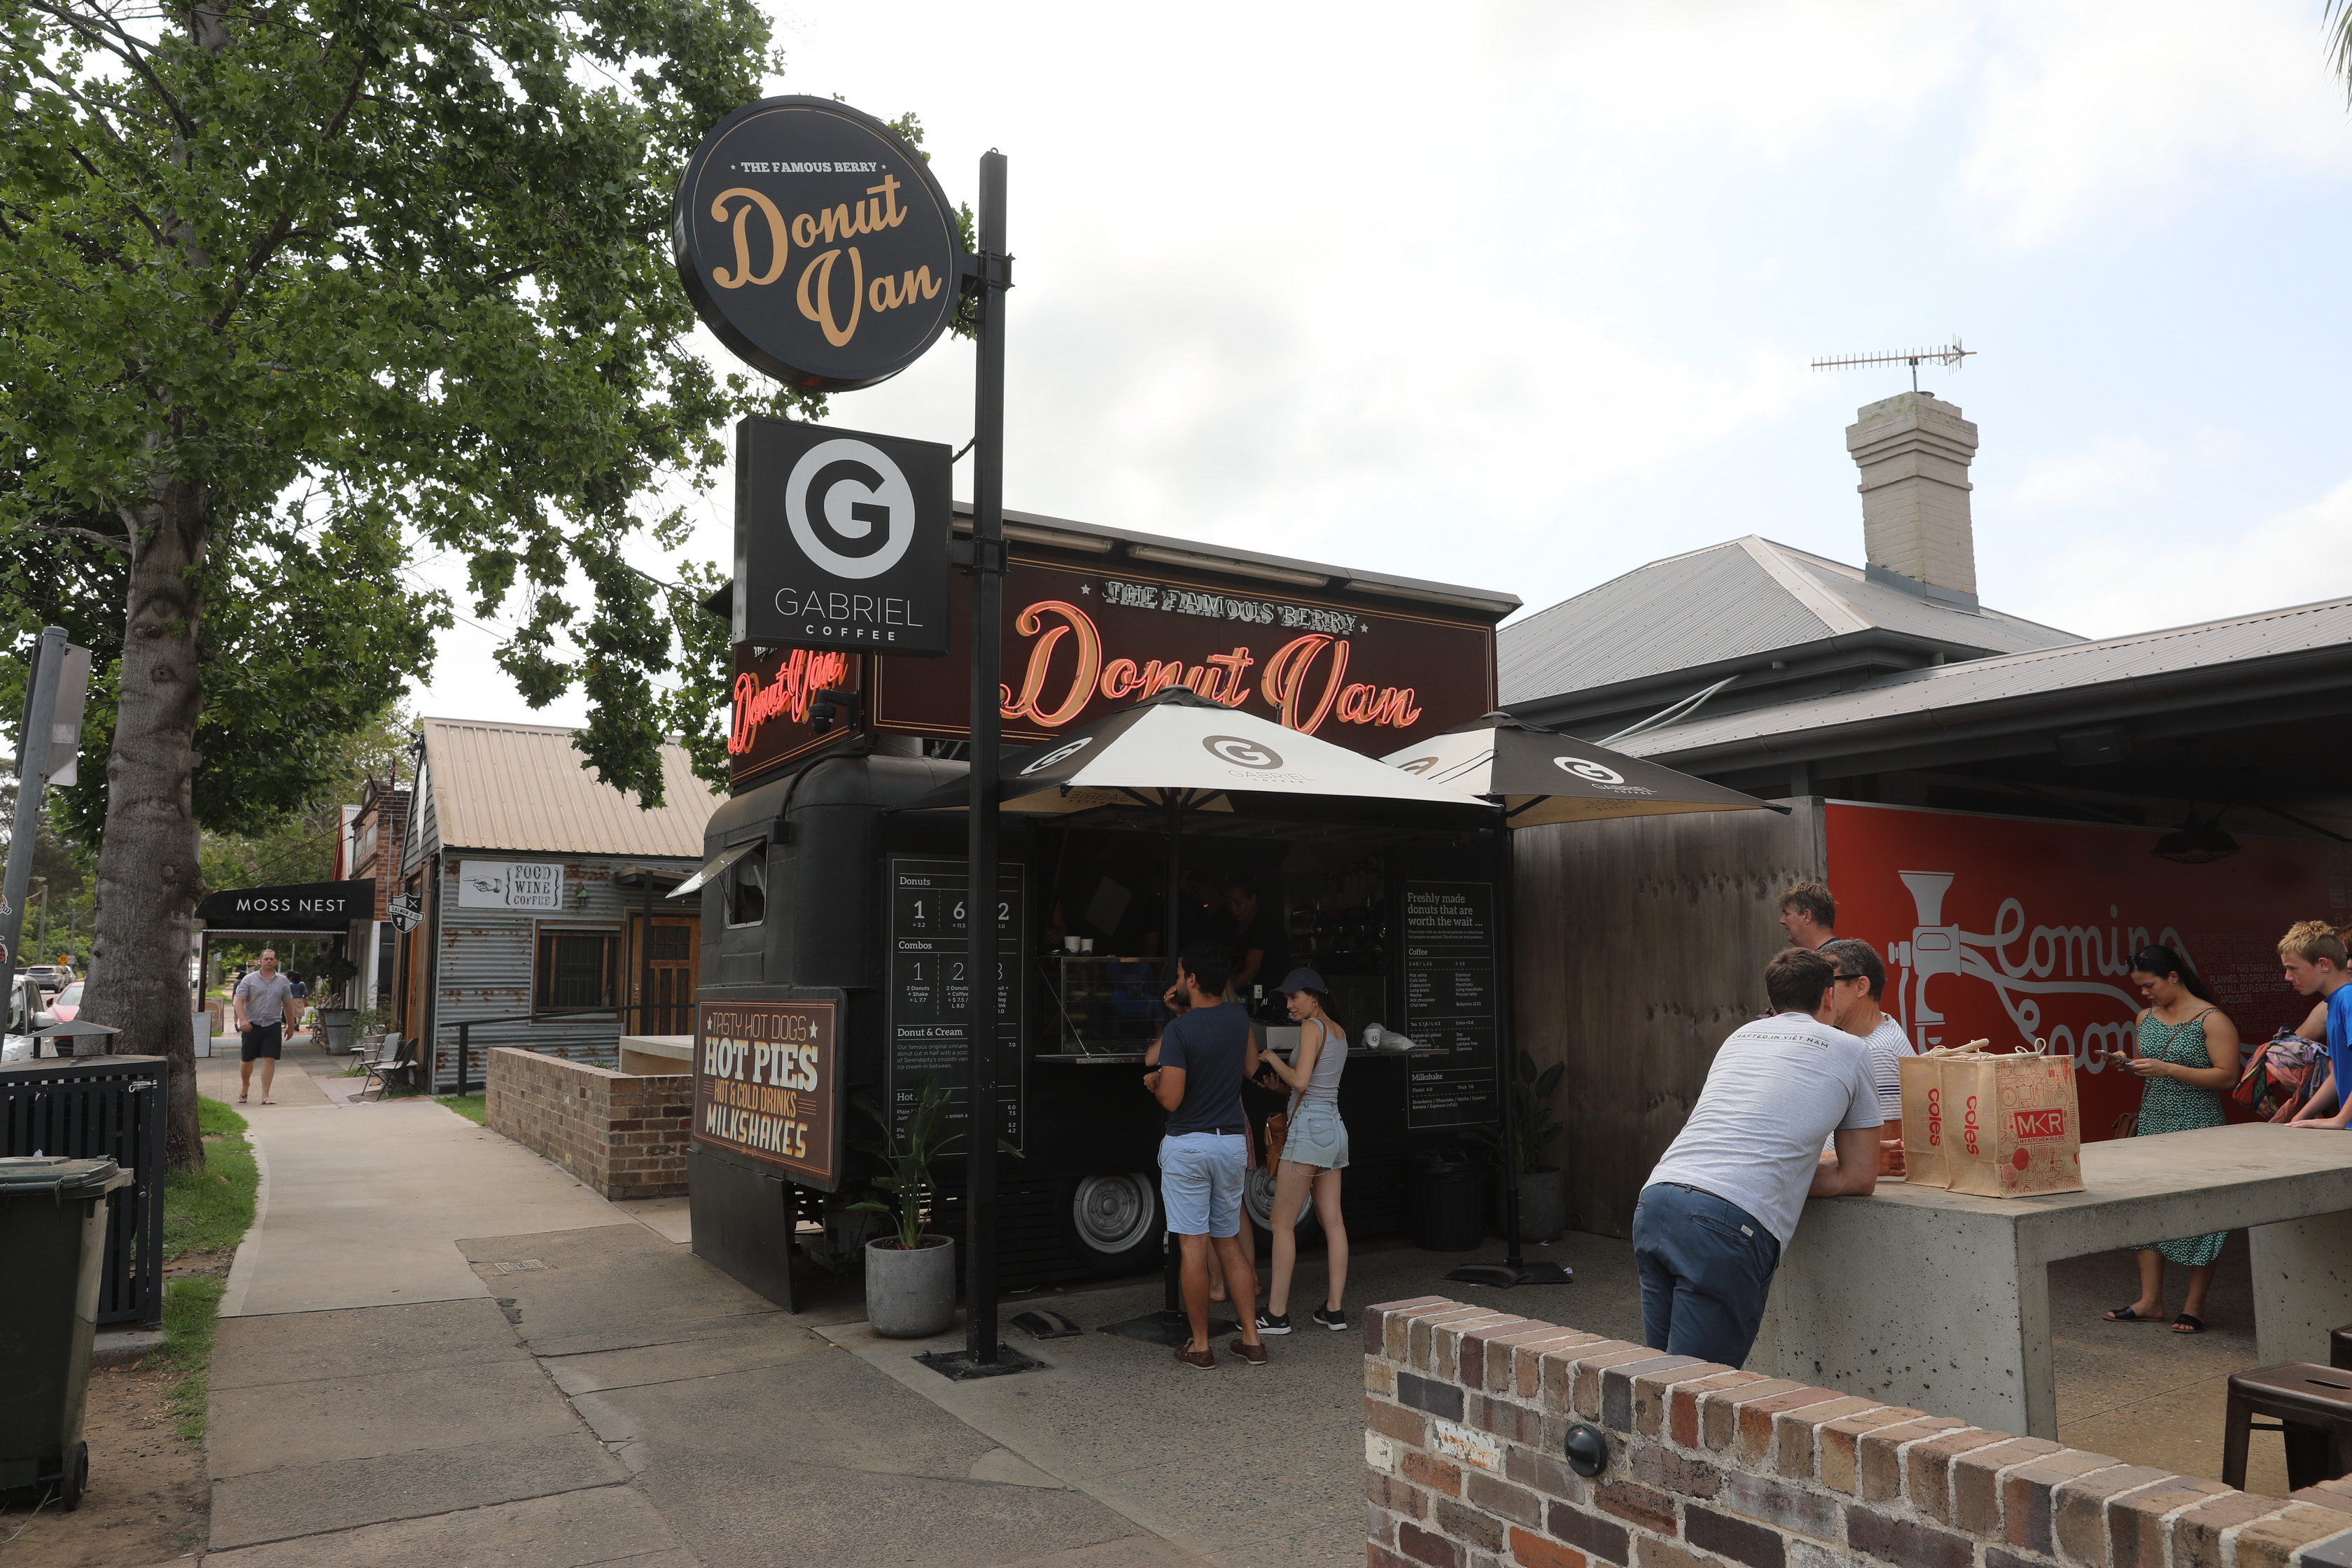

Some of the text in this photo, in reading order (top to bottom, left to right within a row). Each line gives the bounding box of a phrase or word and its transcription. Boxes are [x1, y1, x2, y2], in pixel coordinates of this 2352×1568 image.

[740, 162, 877, 173] THE FAMOUS BERRY
[710, 174, 908, 289] Donut
[796, 246, 942, 347] Van
[775, 588, 923, 627] GABRIEL
[1102, 581, 1358, 635] THE FAMOUS BERRY
[806, 624, 895, 641] COFFEE
[1000, 600, 1422, 736] Donut Van
[728, 649, 848, 755] Donut Van
[1228, 770, 1315, 780] GABRIEL
[1592, 783, 1658, 793] GABRIEL
[514, 865, 552, 879] FOOD
[899, 876, 931, 886] Donuts
[514, 881, 551, 895] WINE
[513, 895, 551, 906] COFFEE
[1407, 892, 1466, 904] Freshly made
[236, 899, 346, 911] MOSS NEST
[391, 906, 410, 916] SALMON
[913, 900, 1009, 920] 1 6 2
[1407, 904, 1438, 914] donuts
[1440, 904, 1457, 914] that
[1408, 916, 1473, 926] worth the wait
[898, 941, 932, 949] Combos
[913, 962, 923, 981] 1
[953, 962, 964, 981] 2
[2237, 964, 2249, 973] HAS
[2249, 964, 2268, 972] TAKEN
[2249, 974, 2264, 983] OPEN
[2266, 974, 2277, 982] OUR
[2213, 983, 2292, 994] YOU PLEASE ACCEPT
[712, 1012, 806, 1042] TASTY HOT DOGS
[897, 1028, 963, 1037] Donut & Cream
[1807, 1037, 1828, 1048] NAM
[704, 1036, 818, 1093] HOT PIES
[1411, 1072, 1443, 1081] Milkshake
[714, 1078, 797, 1118] HOT & COLD DRINKS
[896, 1093, 913, 1101] Hot
[1928, 1088, 1942, 1147] coles
[2017, 1112, 2064, 1136] MKR
[706, 1102, 808, 1158] MILKSHAKES
[1963, 1096, 1979, 1155] coles
